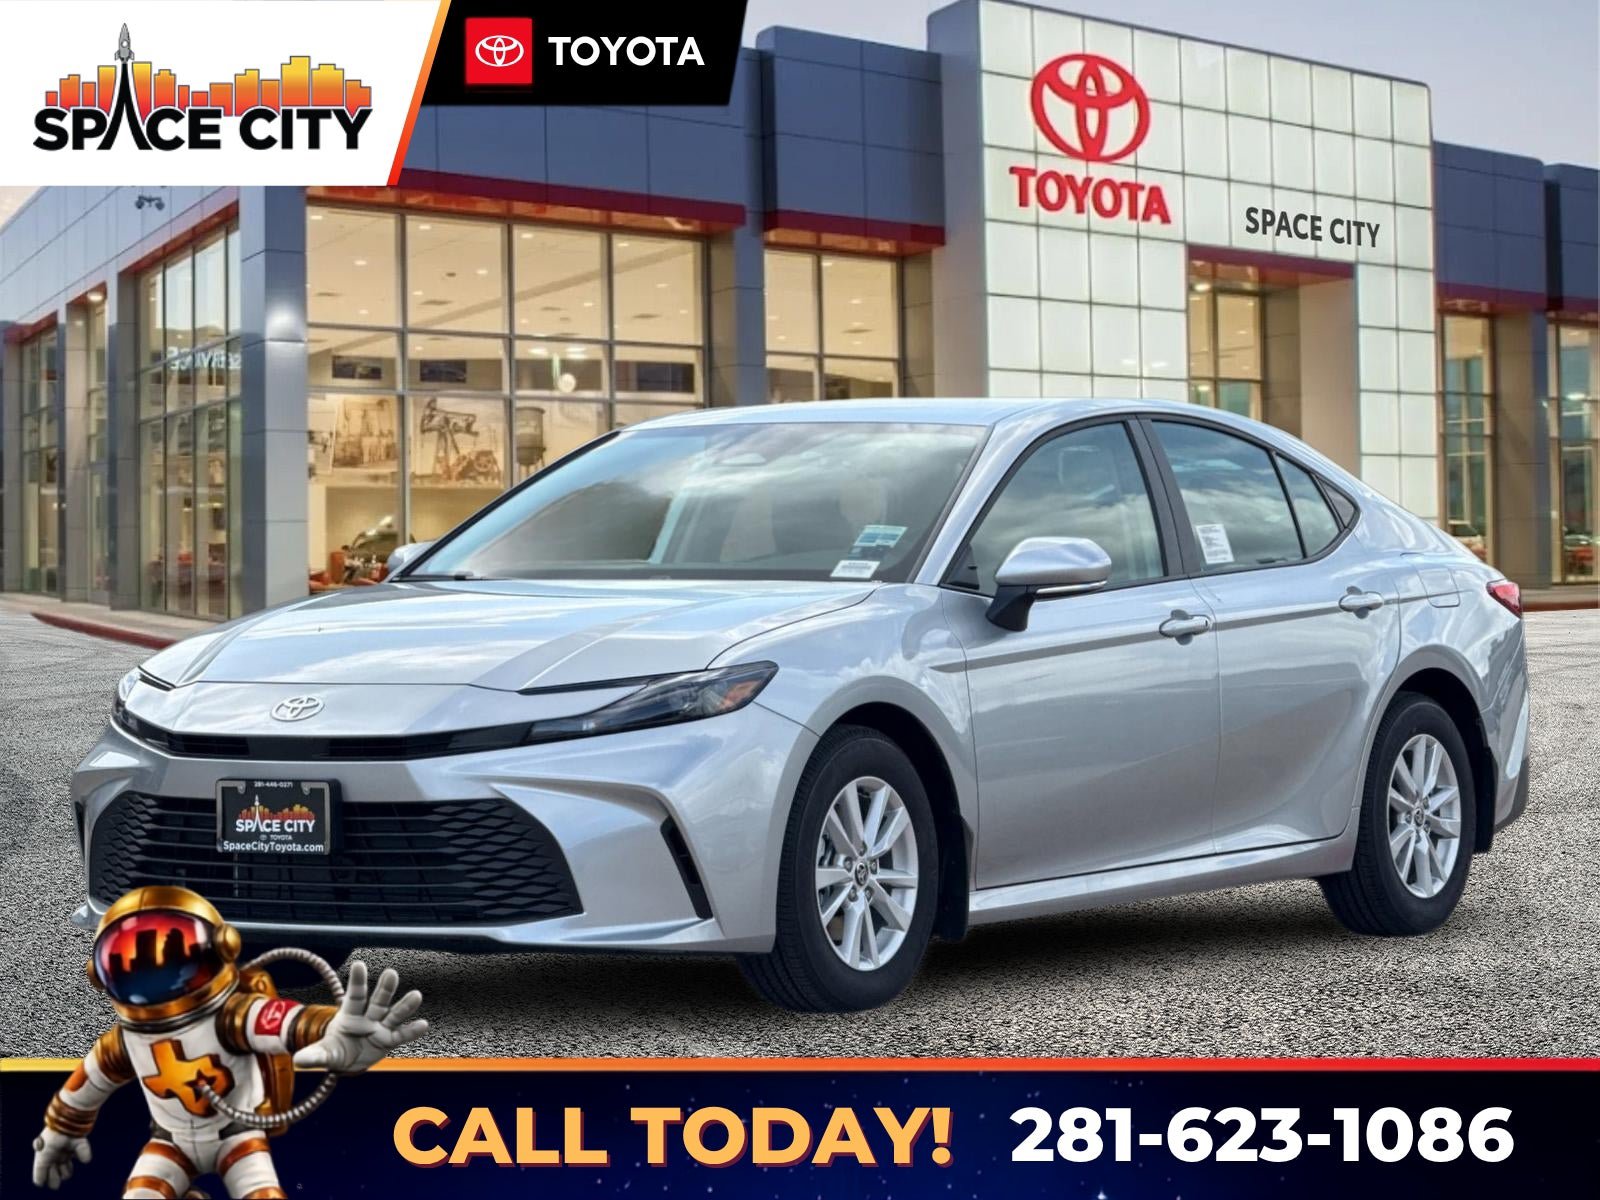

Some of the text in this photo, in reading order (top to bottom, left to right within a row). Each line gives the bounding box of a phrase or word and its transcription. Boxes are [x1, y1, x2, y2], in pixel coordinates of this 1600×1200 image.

[1009, 166, 1171, 225] TOYOTA
[1245, 206, 1381, 248] SPACE CITY
[235, 817, 316, 833] SPACE CITY
[223, 841, 324, 853] SpaceCityToyota.com
